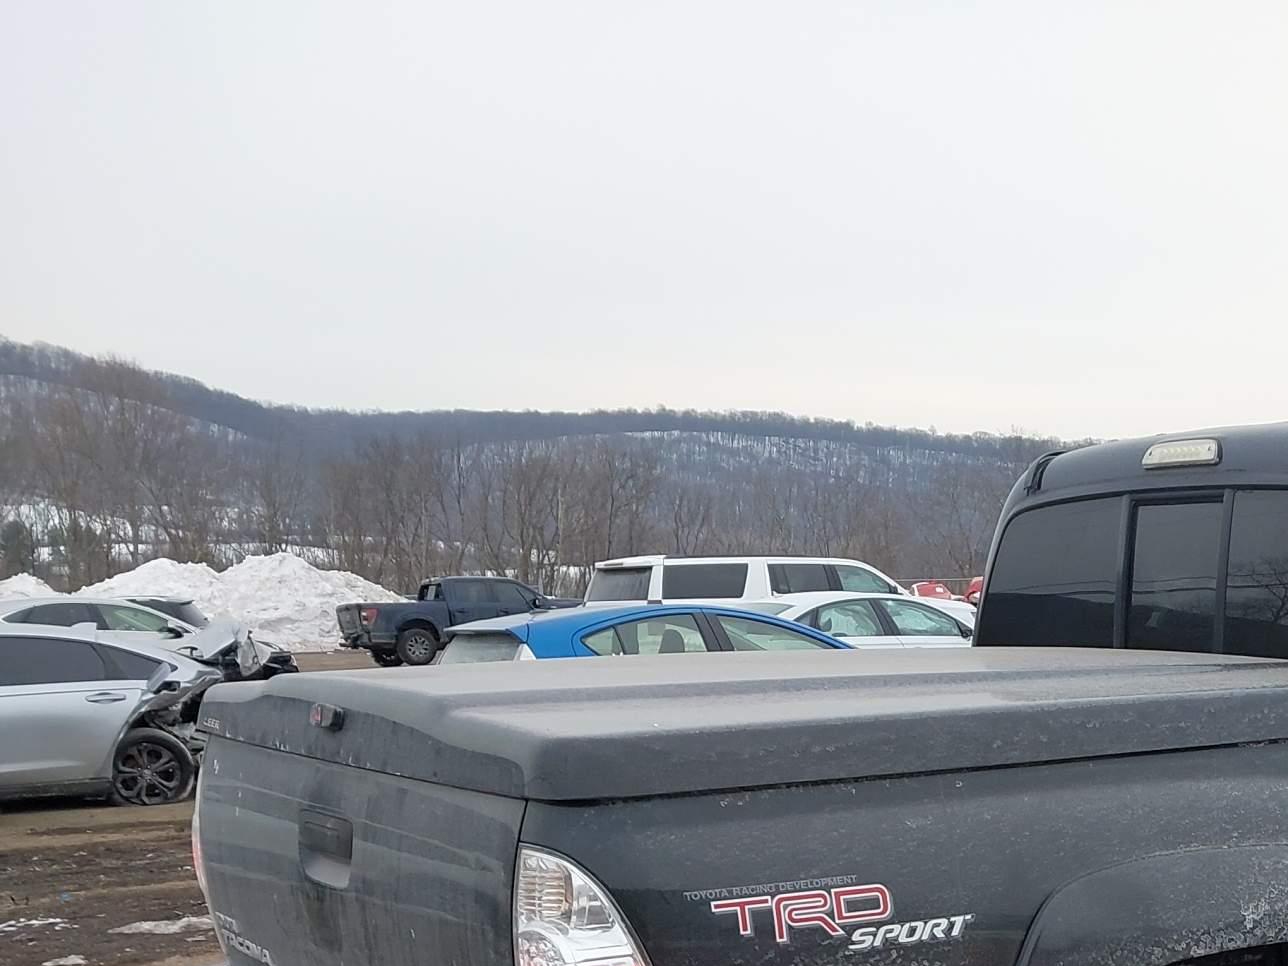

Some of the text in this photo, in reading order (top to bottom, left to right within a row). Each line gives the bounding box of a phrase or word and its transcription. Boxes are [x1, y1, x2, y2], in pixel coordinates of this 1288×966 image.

[683, 874, 857, 901] TOYOTA RACING DEVELOPMENT
[711, 883, 976, 950] TRD SPORT
